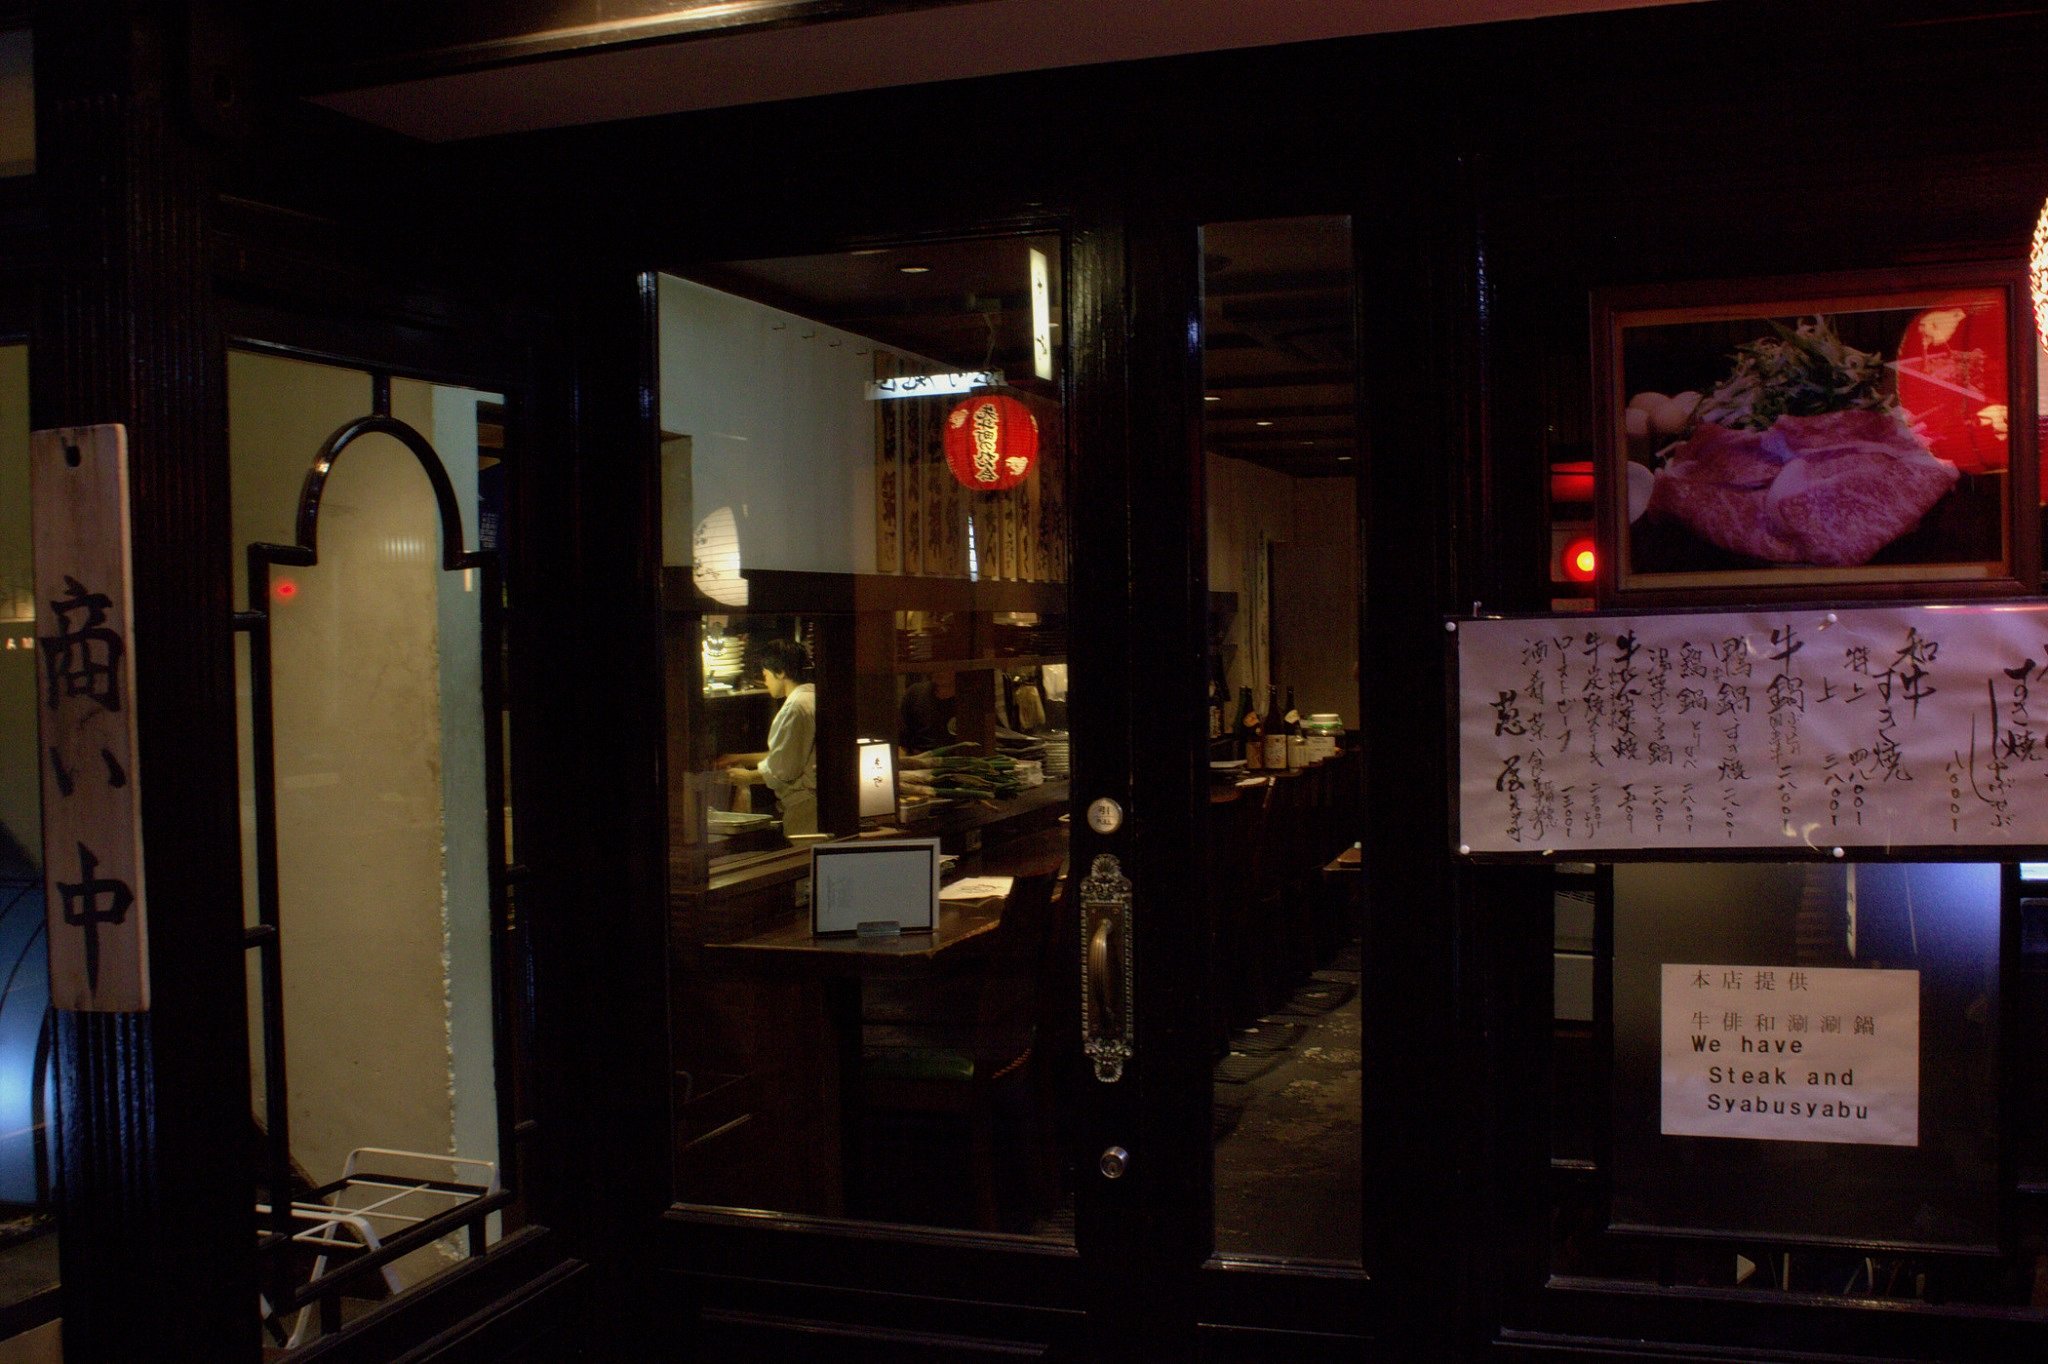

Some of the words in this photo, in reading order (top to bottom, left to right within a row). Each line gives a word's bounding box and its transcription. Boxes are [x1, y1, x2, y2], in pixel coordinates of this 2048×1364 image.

[38, 575, 134, 994] 商い中
[1691, 970, 1808, 991] 本店提供
[1691, 1035, 1721, 1053] We
[1741, 1036, 1803, 1053] have
[1709, 1066, 1787, 1085] Steak
[1807, 1069, 1854, 1086] and
[1707, 1094, 1868, 1119] Syabusyabu
